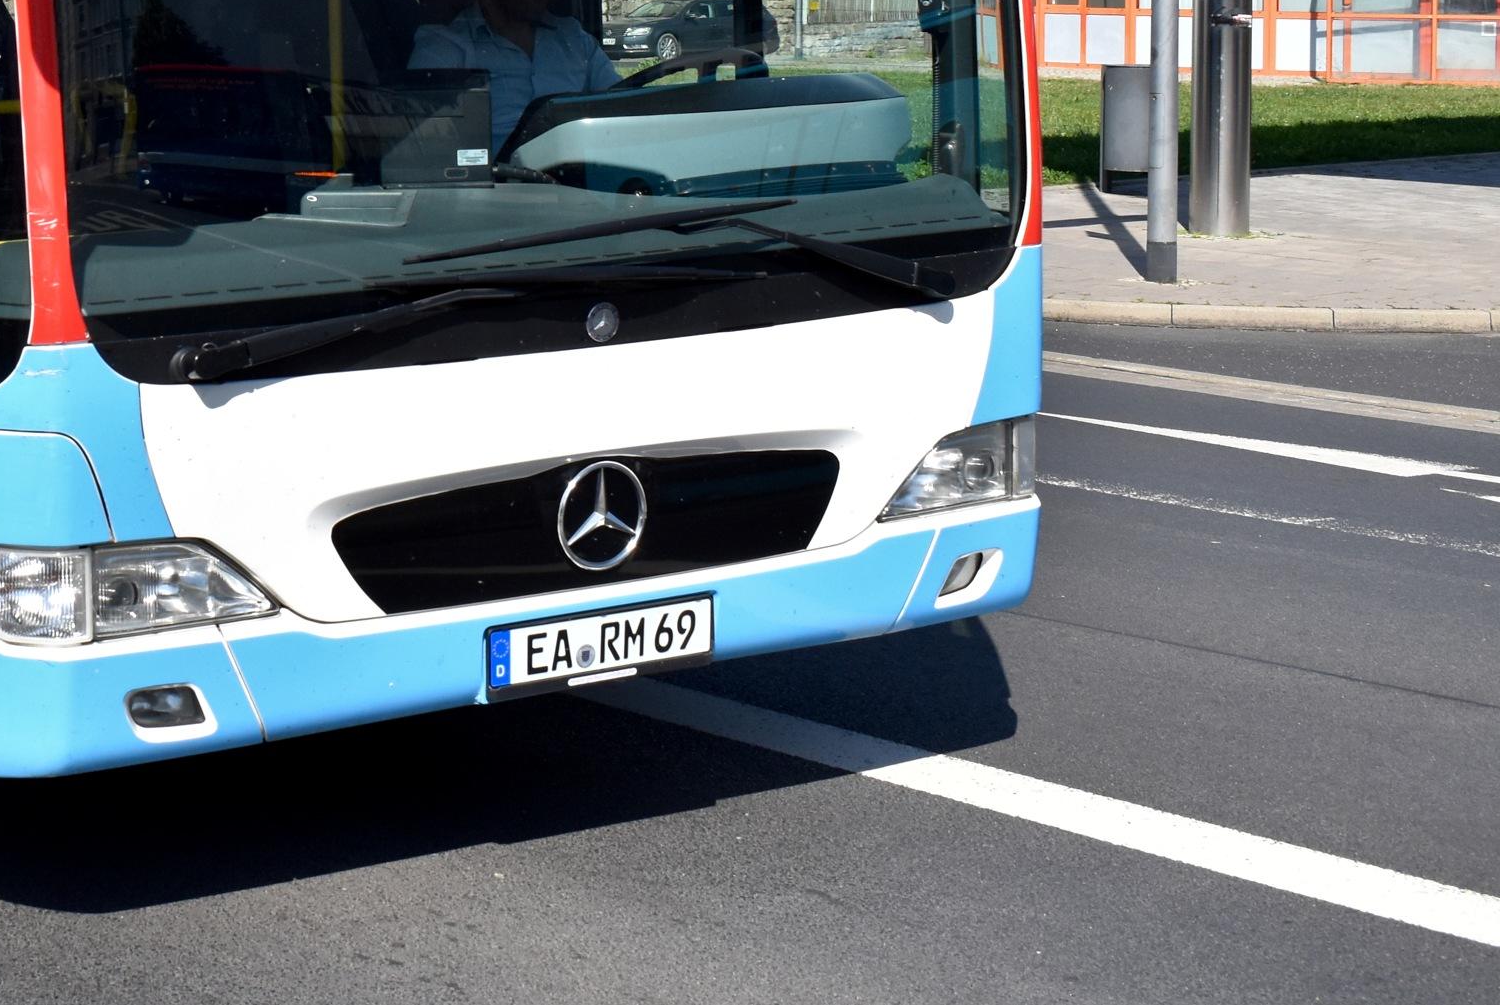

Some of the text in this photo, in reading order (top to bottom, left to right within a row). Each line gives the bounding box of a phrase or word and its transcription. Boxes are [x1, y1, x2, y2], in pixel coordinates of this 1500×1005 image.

[527, 609, 697, 676] EA RM 69
[495, 664, 505, 677] D
